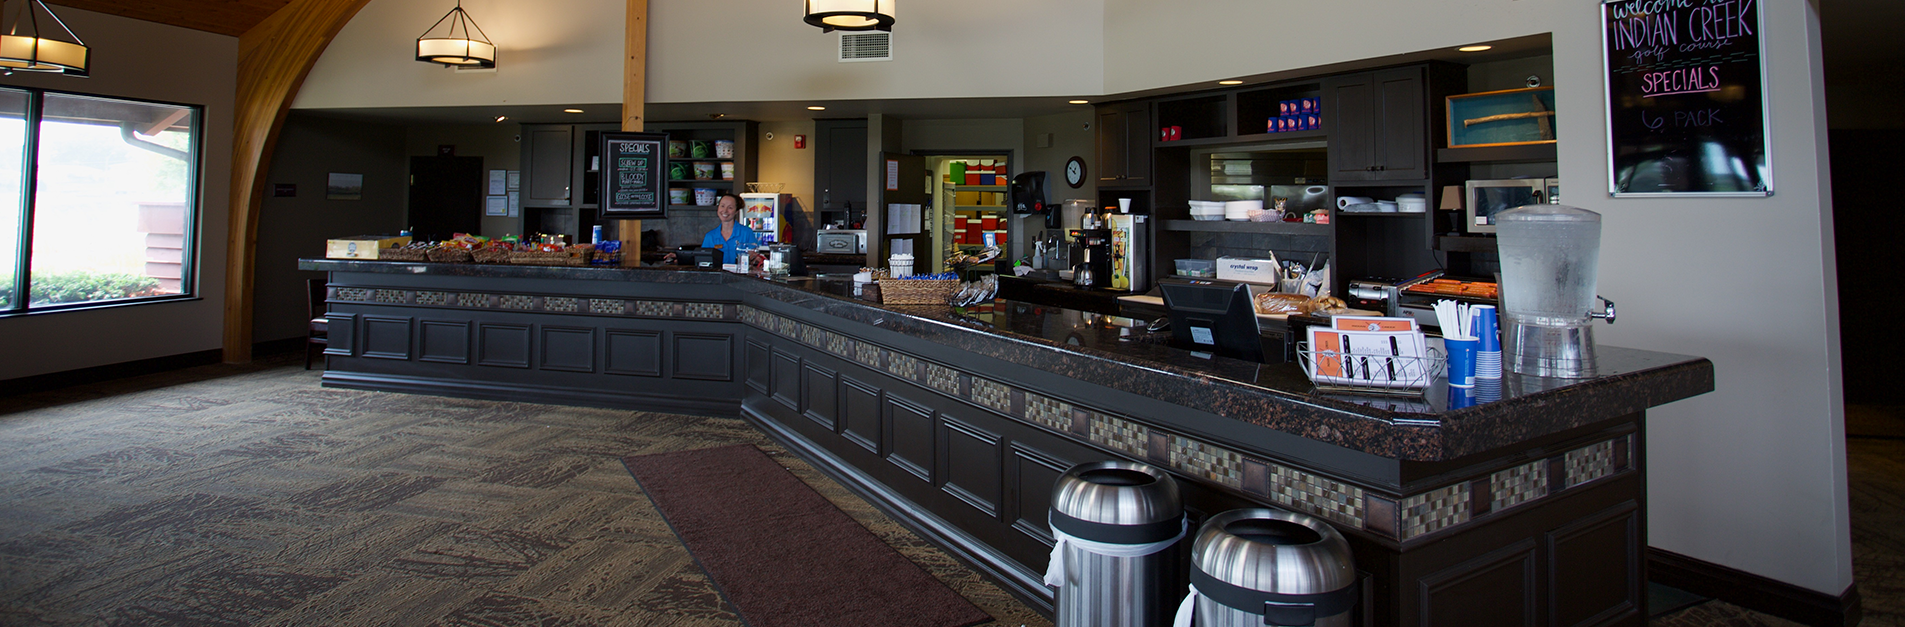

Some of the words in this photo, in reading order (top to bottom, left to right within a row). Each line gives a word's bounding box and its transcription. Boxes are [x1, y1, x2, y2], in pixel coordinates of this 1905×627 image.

[1613, 10, 1677, 50] INDIAN
[1688, 0, 1752, 42] CREEK
[1627, 44, 1670, 64] golf
[1679, 39, 1733, 53] course
[1641, 66, 1720, 93] SPECIALS
[1641, 109, 1664, 129] 6
[1674, 108, 1723, 127] PACK
[619, 143, 650, 153] SPECIALS
